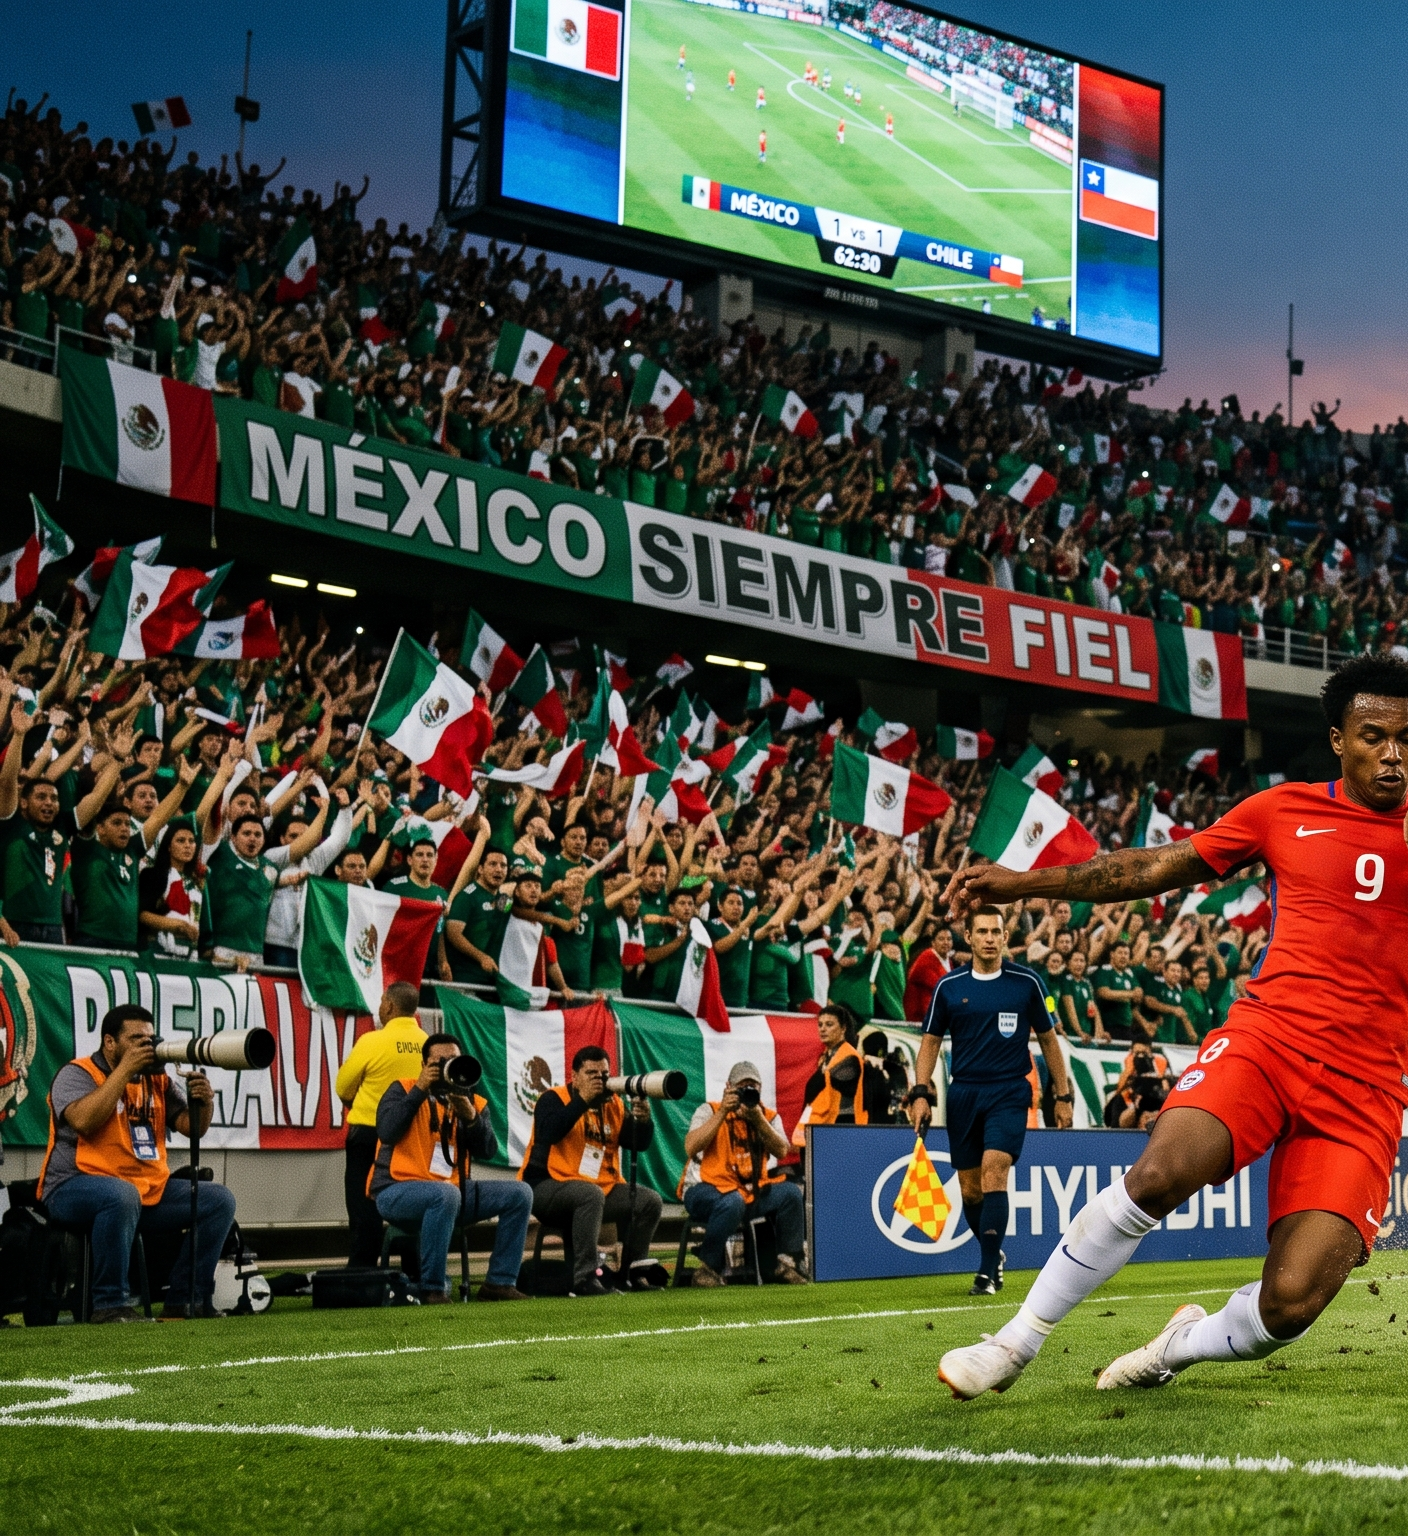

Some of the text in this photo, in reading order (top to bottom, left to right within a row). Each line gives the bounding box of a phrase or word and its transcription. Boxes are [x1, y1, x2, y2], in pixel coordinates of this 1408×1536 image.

[730, 192, 799, 226] MÉXICO
[833, 218, 883, 248] 1 vs 1
[834, 246, 881, 273] 62:30
[926, 242, 973, 270] CHILE
[246, 420, 1151, 690] MÉXICO SIEMPRE FIEL
[1354, 853, 1385, 902] 9
